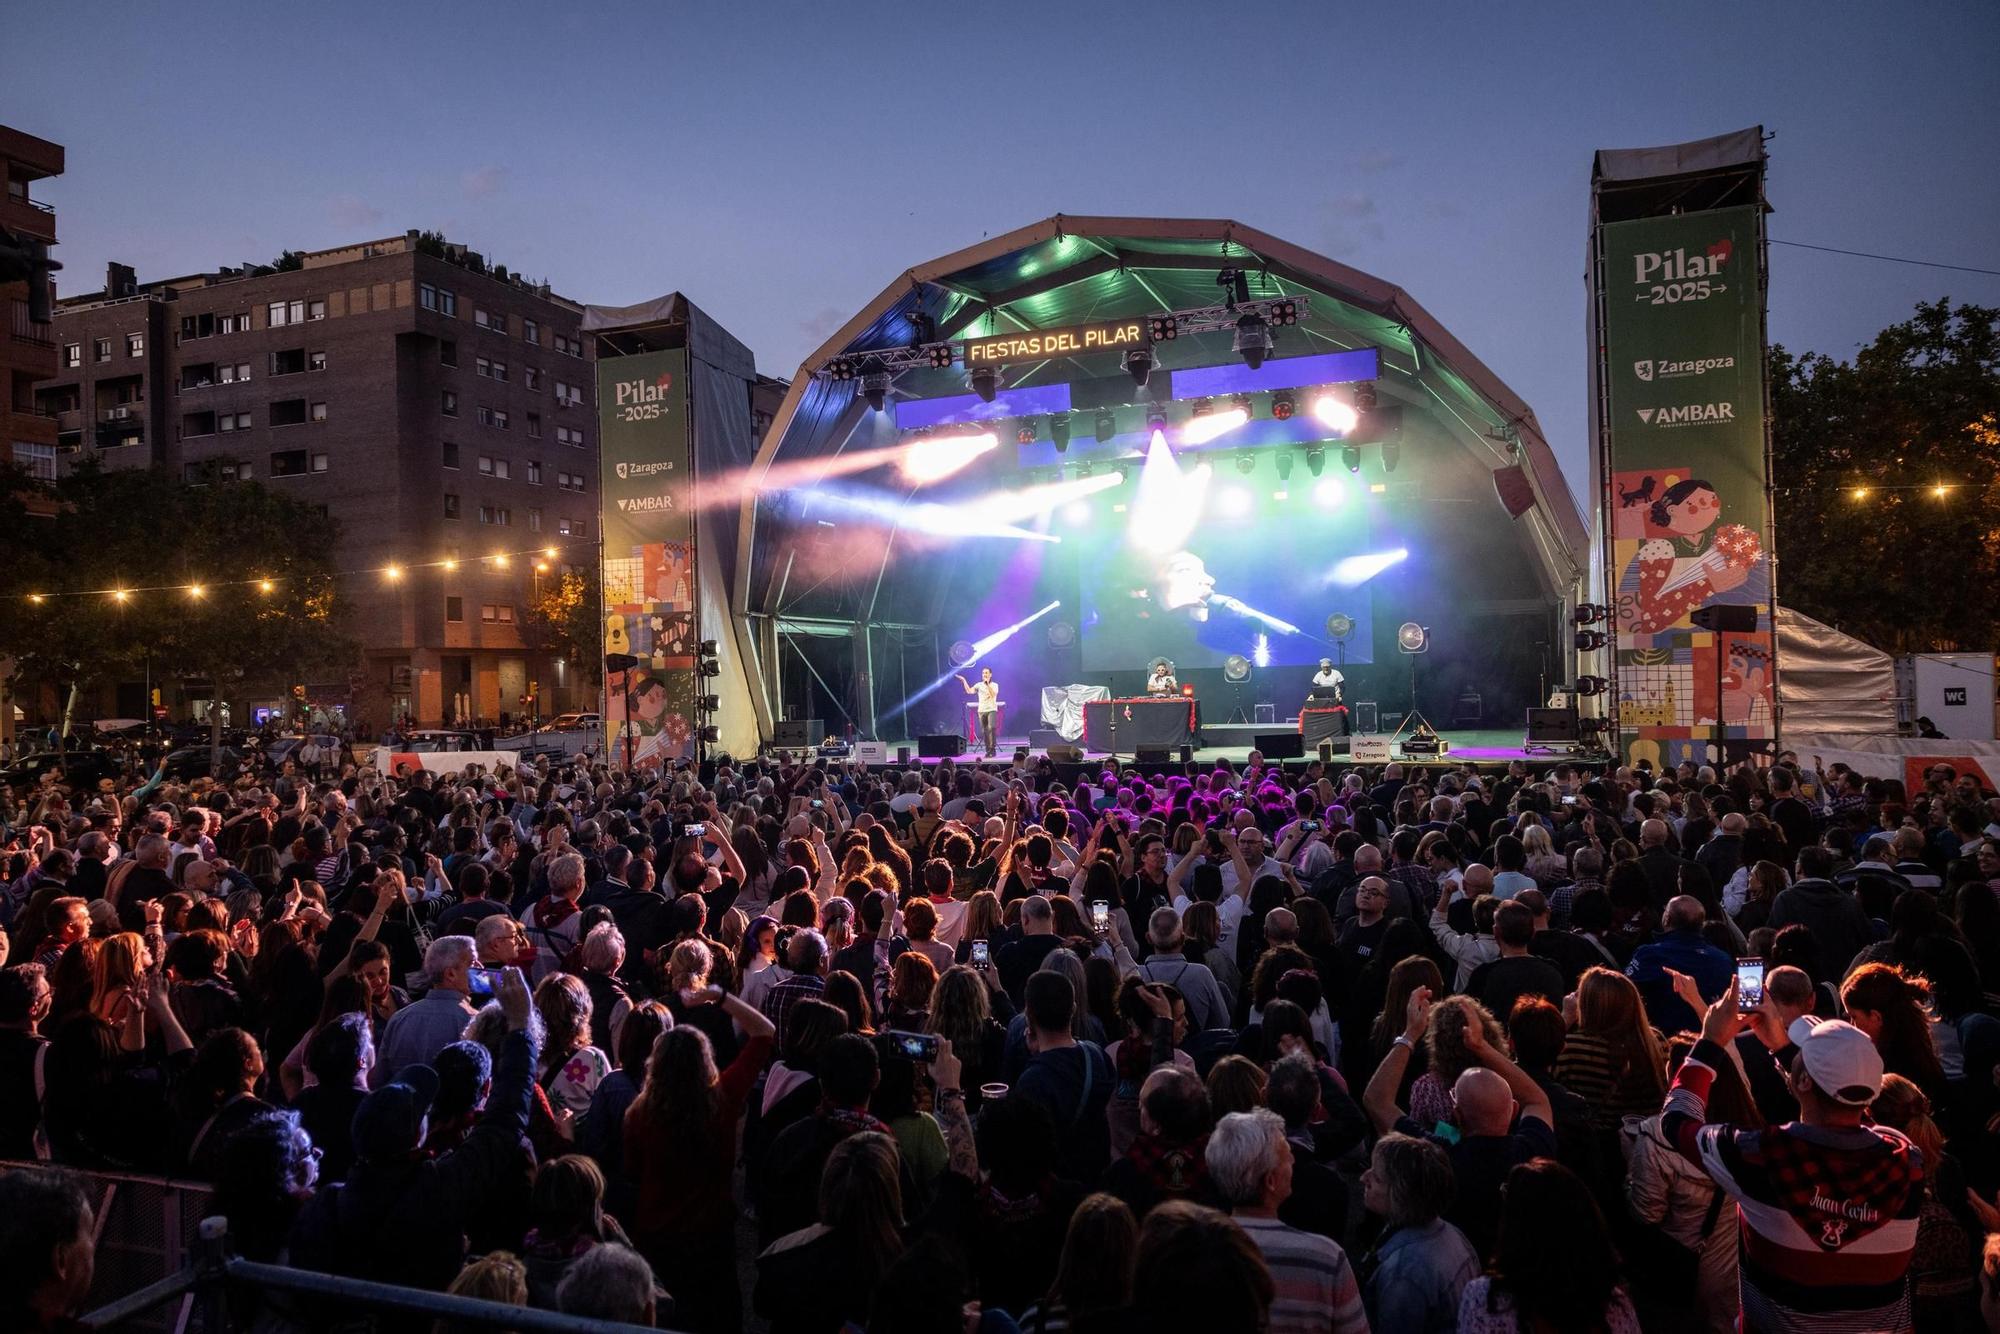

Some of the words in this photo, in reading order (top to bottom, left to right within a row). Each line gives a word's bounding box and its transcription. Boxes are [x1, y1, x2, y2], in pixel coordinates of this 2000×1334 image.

[1634, 247, 1727, 284] Pilar
[1651, 280, 1711, 305] 2025
[971, 338, 1041, 361] FIESTAS
[1045, 334, 1080, 353] DEL
[1085, 325, 1140, 347] PILAR
[1658, 357, 1734, 374] Zaragoza
[615, 379, 668, 406] Pilar
[625, 404, 660, 421] 2025
[1656, 402, 1735, 424] AMBAR
[630, 461, 673, 475] Zaragoza
[628, 495, 672, 511] AMBAR
[1946, 691, 1965, 702] WC
[1809, 1185, 1839, 1214] Juan
